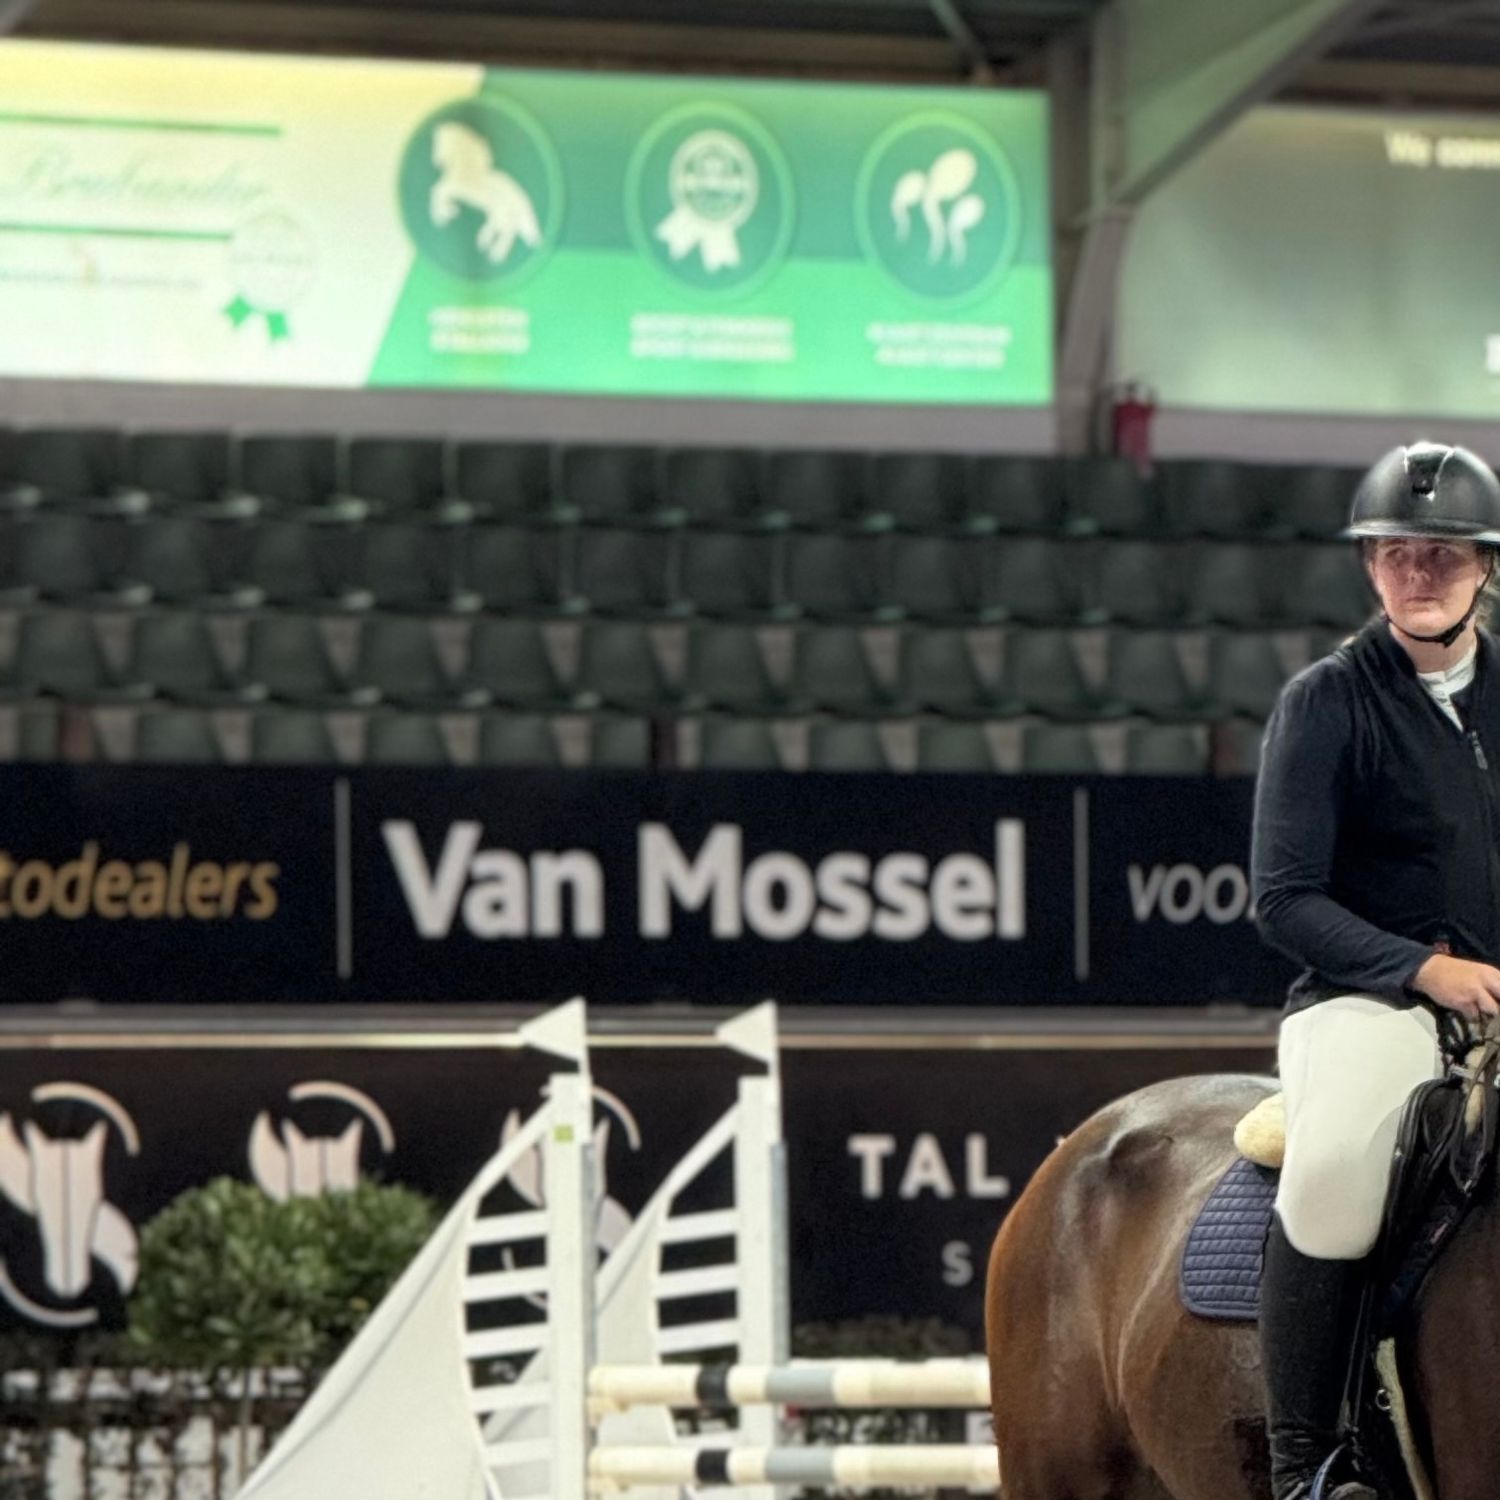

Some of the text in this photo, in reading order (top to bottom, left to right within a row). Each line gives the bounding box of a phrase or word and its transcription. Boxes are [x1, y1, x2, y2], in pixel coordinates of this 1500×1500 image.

[382, 818, 1025, 941] Van Mossel
[1127, 862, 1256, 924] VOO
[847, 1132, 1010, 1199] TAL
